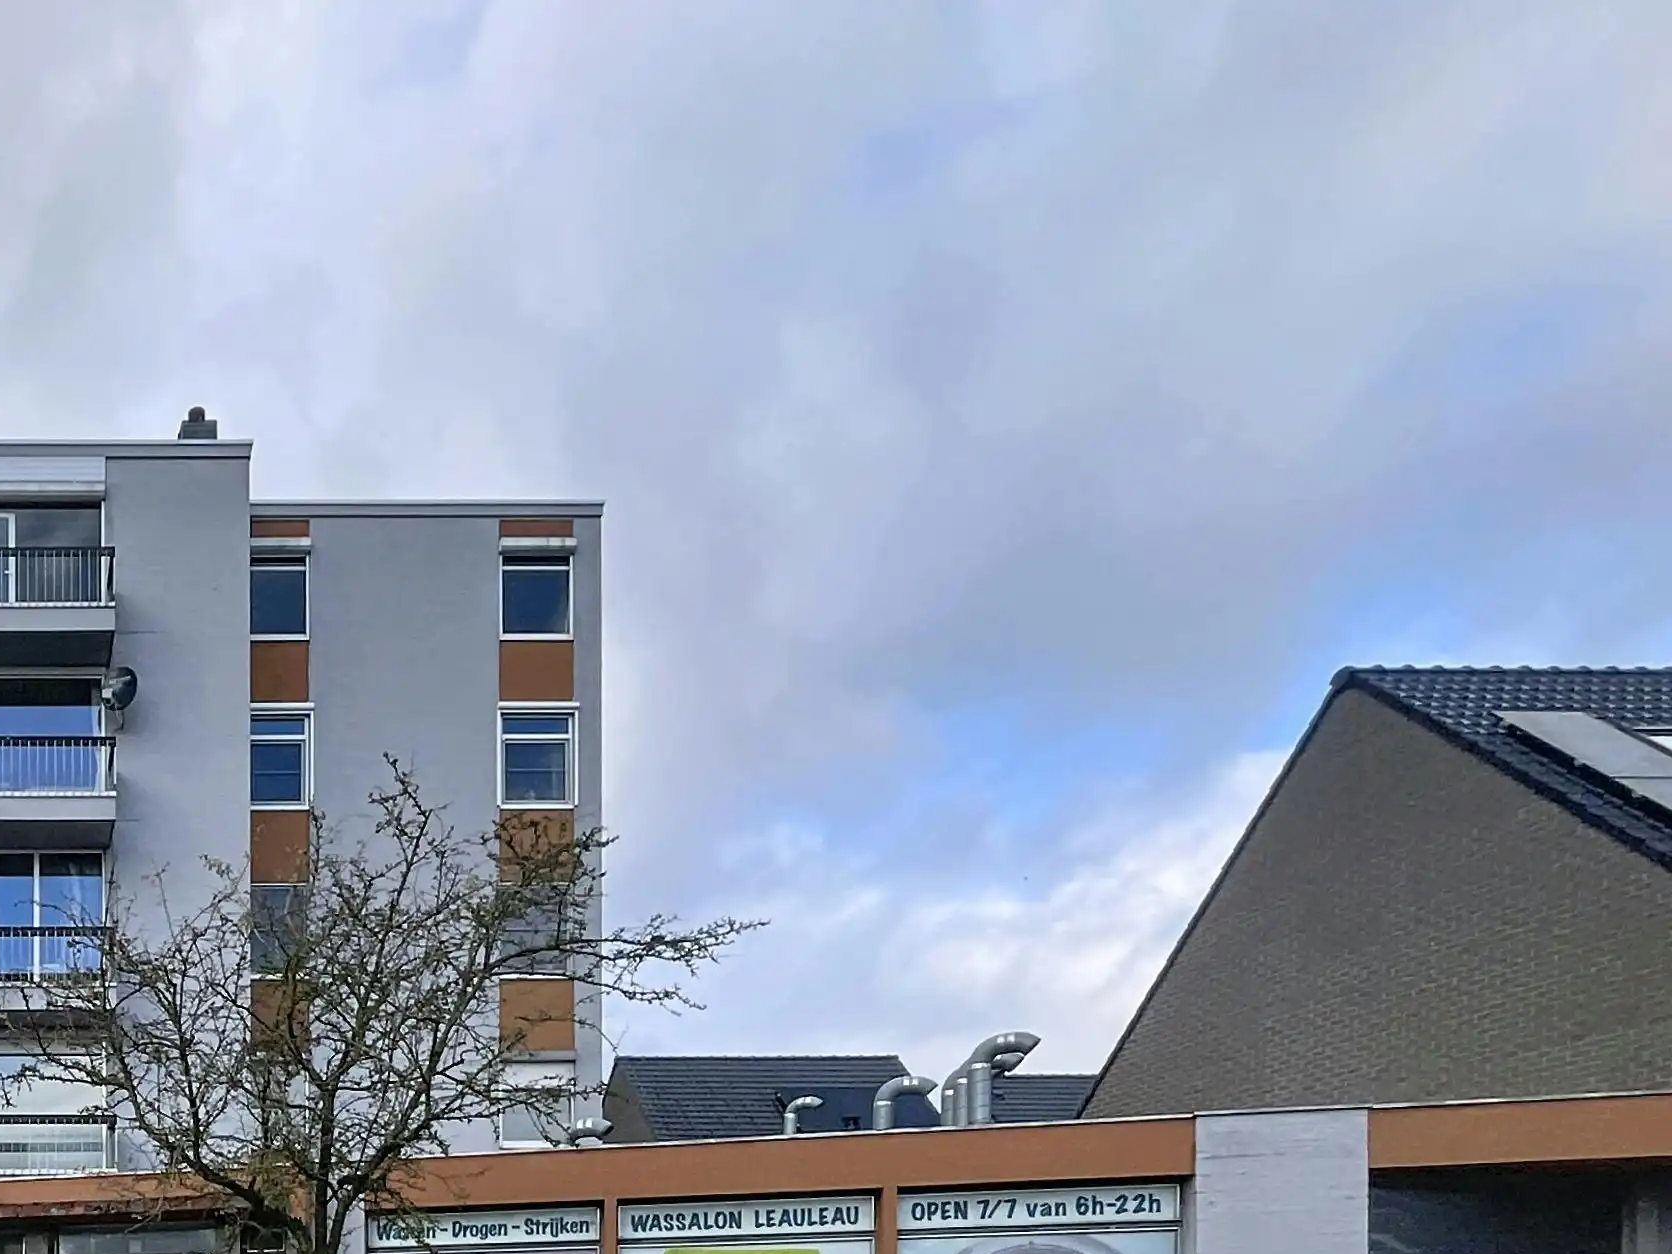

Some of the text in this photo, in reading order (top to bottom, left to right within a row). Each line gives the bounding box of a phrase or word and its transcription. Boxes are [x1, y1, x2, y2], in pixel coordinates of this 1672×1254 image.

[631, 1206, 860, 1233] WASSALON LEAULEAU
[910, 1193, 1162, 1221] OPEN 7/7 van 6h-22h
[451, 1220, 508, 1240] Drogen
[524, 1217, 591, 1238] Strijken
